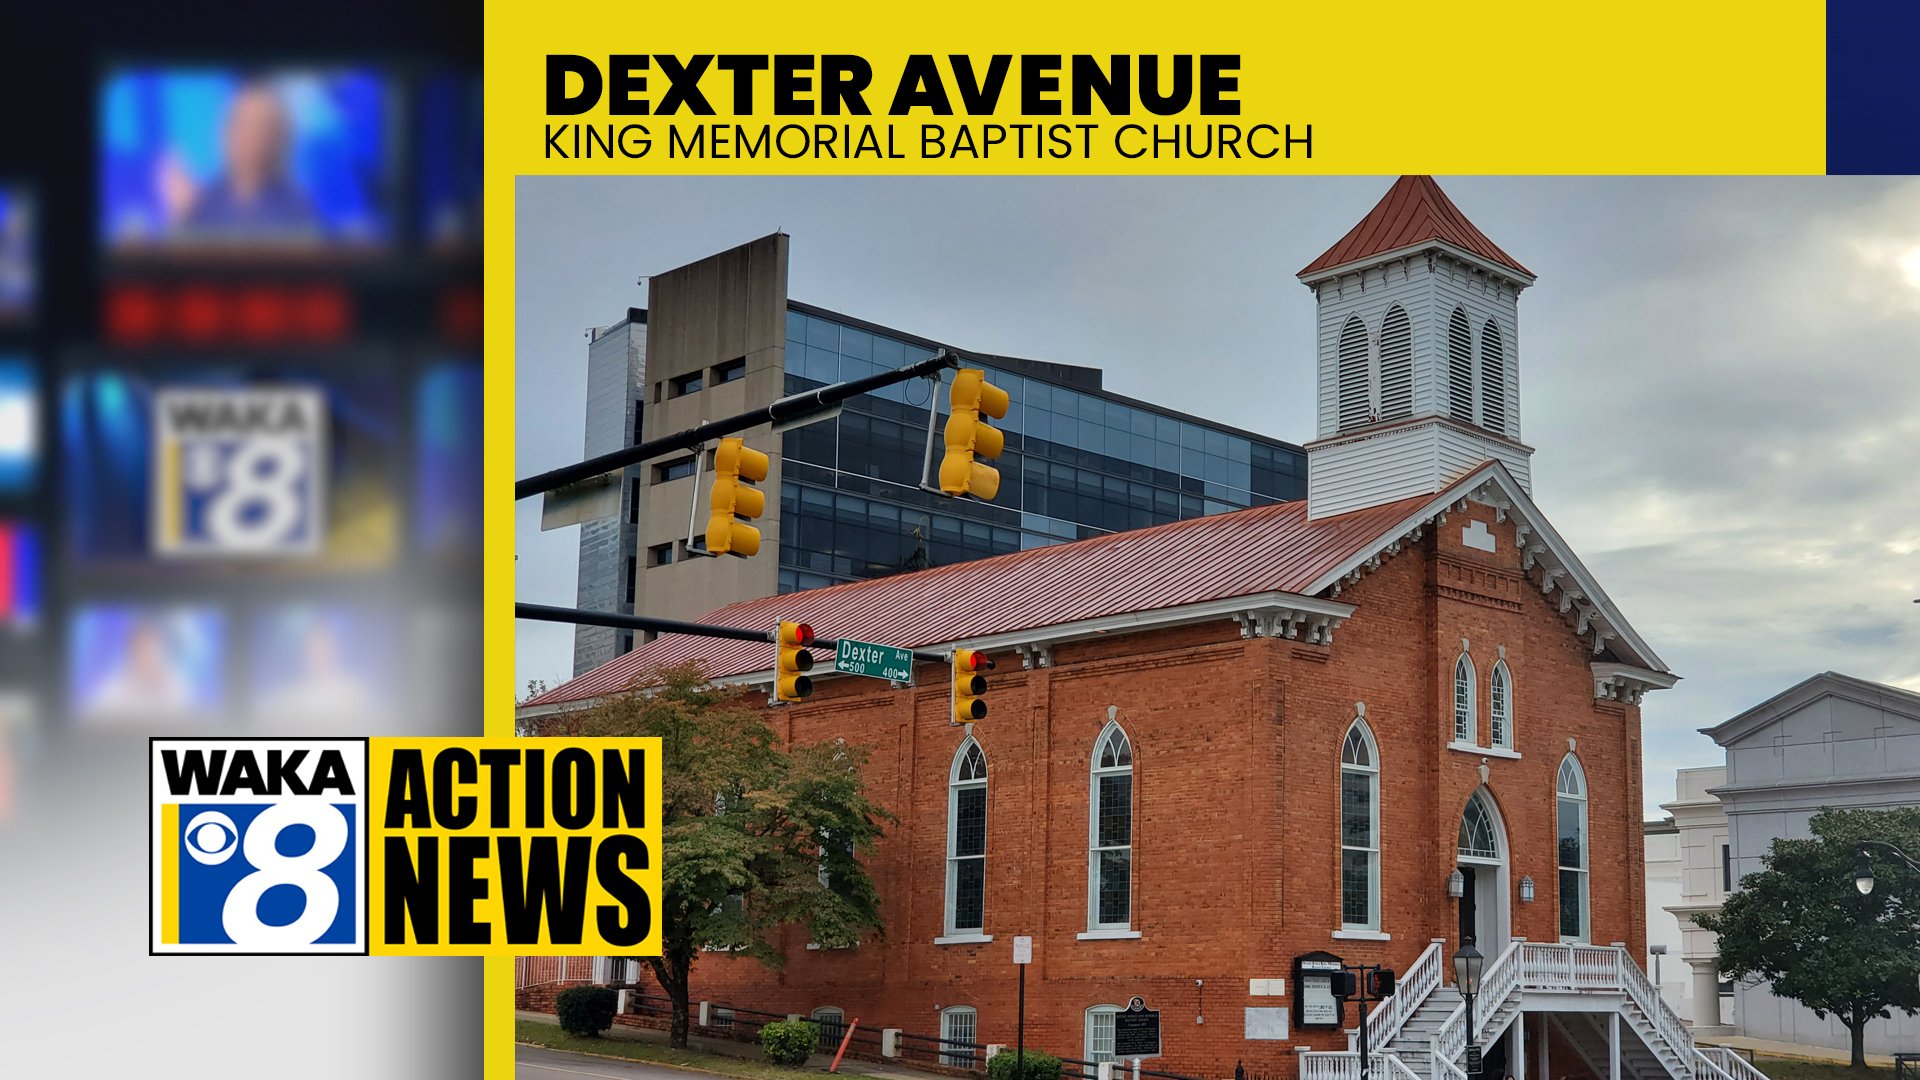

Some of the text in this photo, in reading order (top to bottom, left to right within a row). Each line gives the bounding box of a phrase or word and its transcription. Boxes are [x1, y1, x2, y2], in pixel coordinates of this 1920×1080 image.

[842, 641, 908, 664] Dexter Ave
[849, 661, 865, 674] 500
[883, 667, 898, 679] 400
